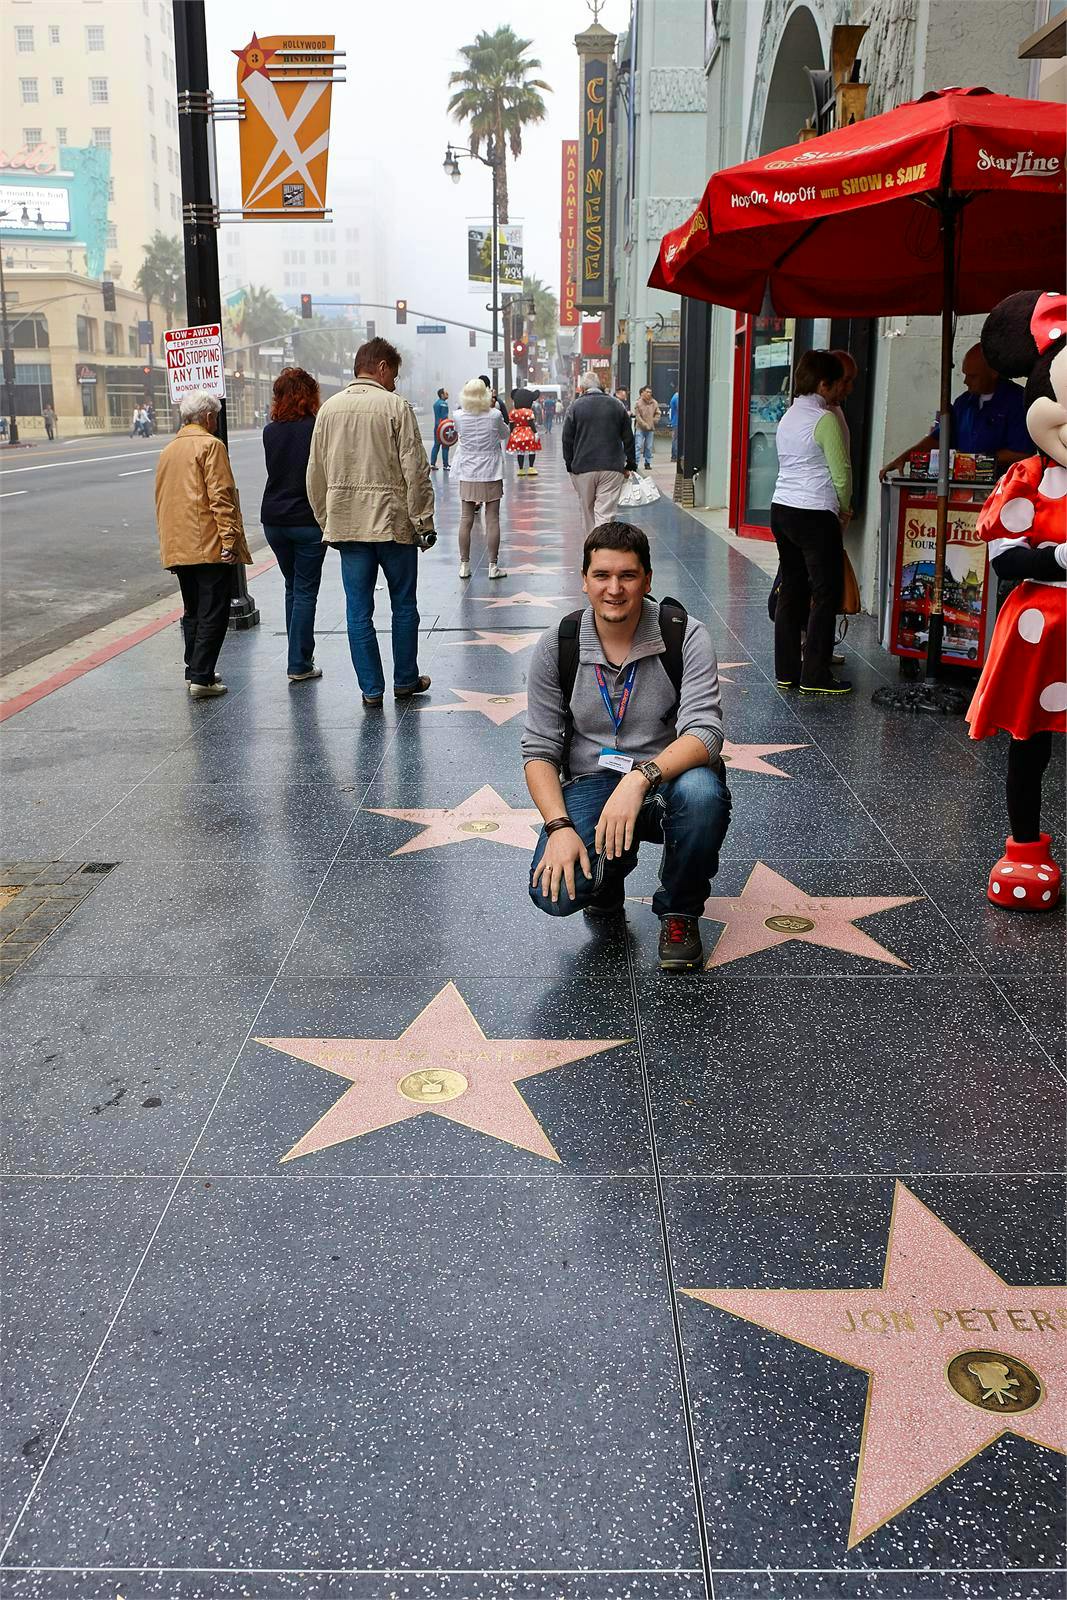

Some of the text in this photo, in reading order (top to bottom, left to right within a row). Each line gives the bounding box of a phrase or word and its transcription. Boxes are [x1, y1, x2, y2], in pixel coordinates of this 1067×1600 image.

[282, 40, 327, 49] HOLLYWOOD
[251, 53, 259, 63] 3
[283, 55, 327, 63] HISTORIC
[976, 148, 1061, 178] StarLine
[585, 77, 604, 280] CHINESE
[820, 187, 840, 199] WITH
[841, 173, 882, 196] SHOW
[885, 174, 895, 188] &
[566, 145, 577, 321] MADAME TUSSAUDS
[171, 328, 213, 340] TOW-AWAY
[173, 337, 213, 348] TEMPORARY
[169, 348, 219, 368] NO STOPPING
[173, 365, 220, 383] ANY TIME
[175, 384, 200, 392] MONDAY
[794, 903, 833, 911] LEE
[838, 1308, 916, 1334] JON
